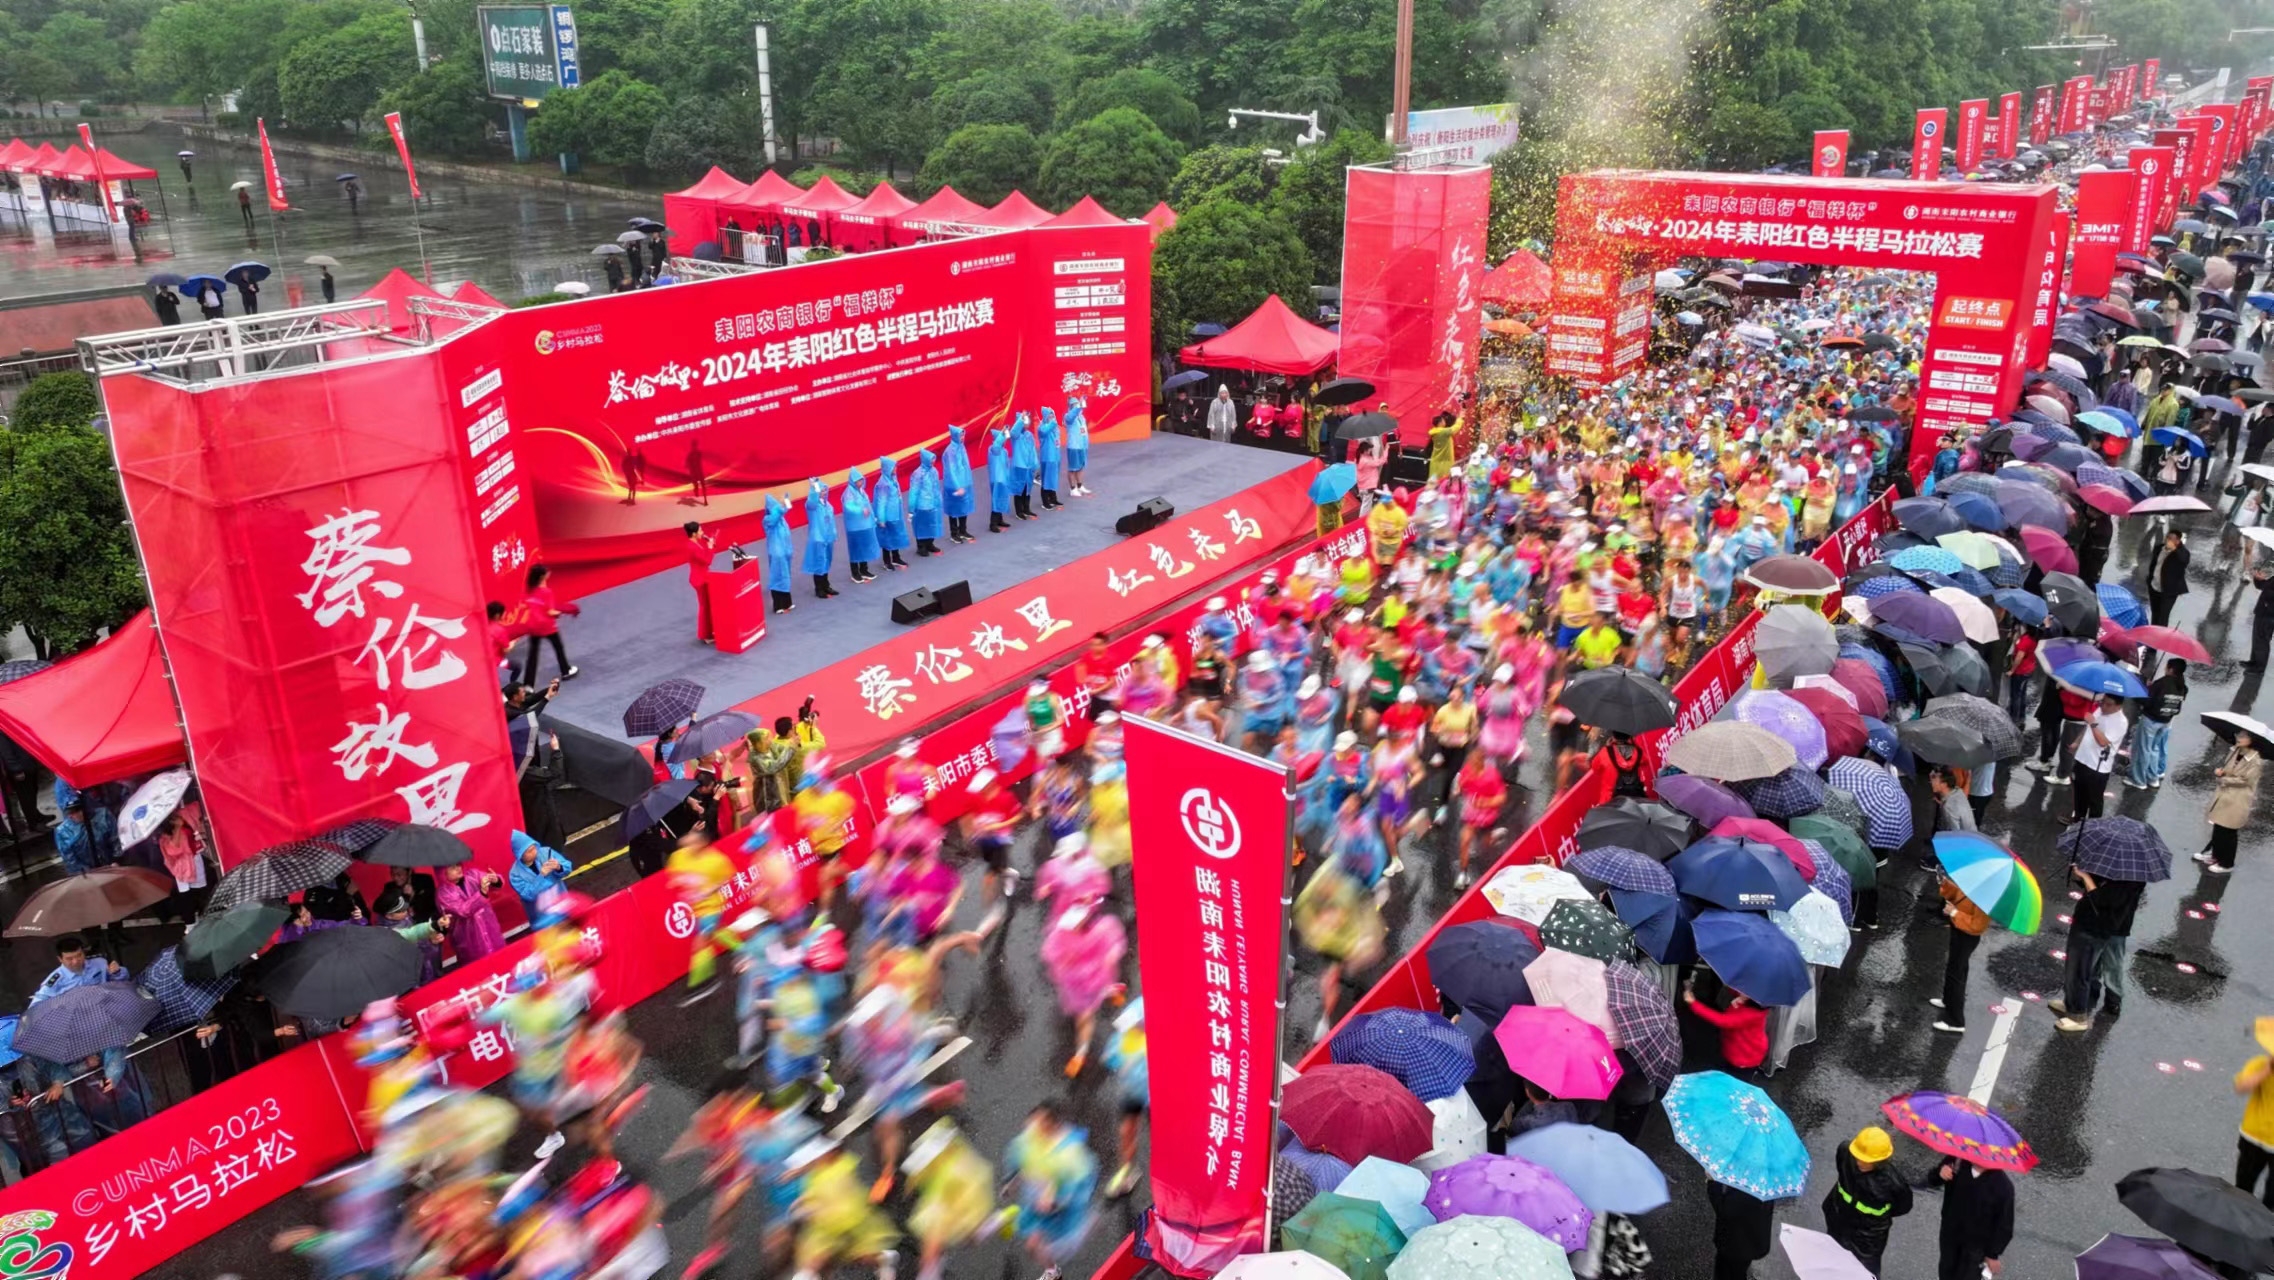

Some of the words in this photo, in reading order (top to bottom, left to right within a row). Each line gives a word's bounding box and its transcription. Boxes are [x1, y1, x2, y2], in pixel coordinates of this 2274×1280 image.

[557, 334, 604, 351] 乡村马拉松
[714, 284, 904, 343] 耒阳农商银行“福祥杯”
[1951, 299, 2002, 316] 起终点
[1975, 317, 2004, 328] FINISH
[294, 506, 490, 834] 蔡伦故里
[854, 596, 1073, 721] 蔡伦故里
[72, 1096, 282, 1217] CUNMA2023
[84, 1128, 298, 1267] 乡村马拉松
